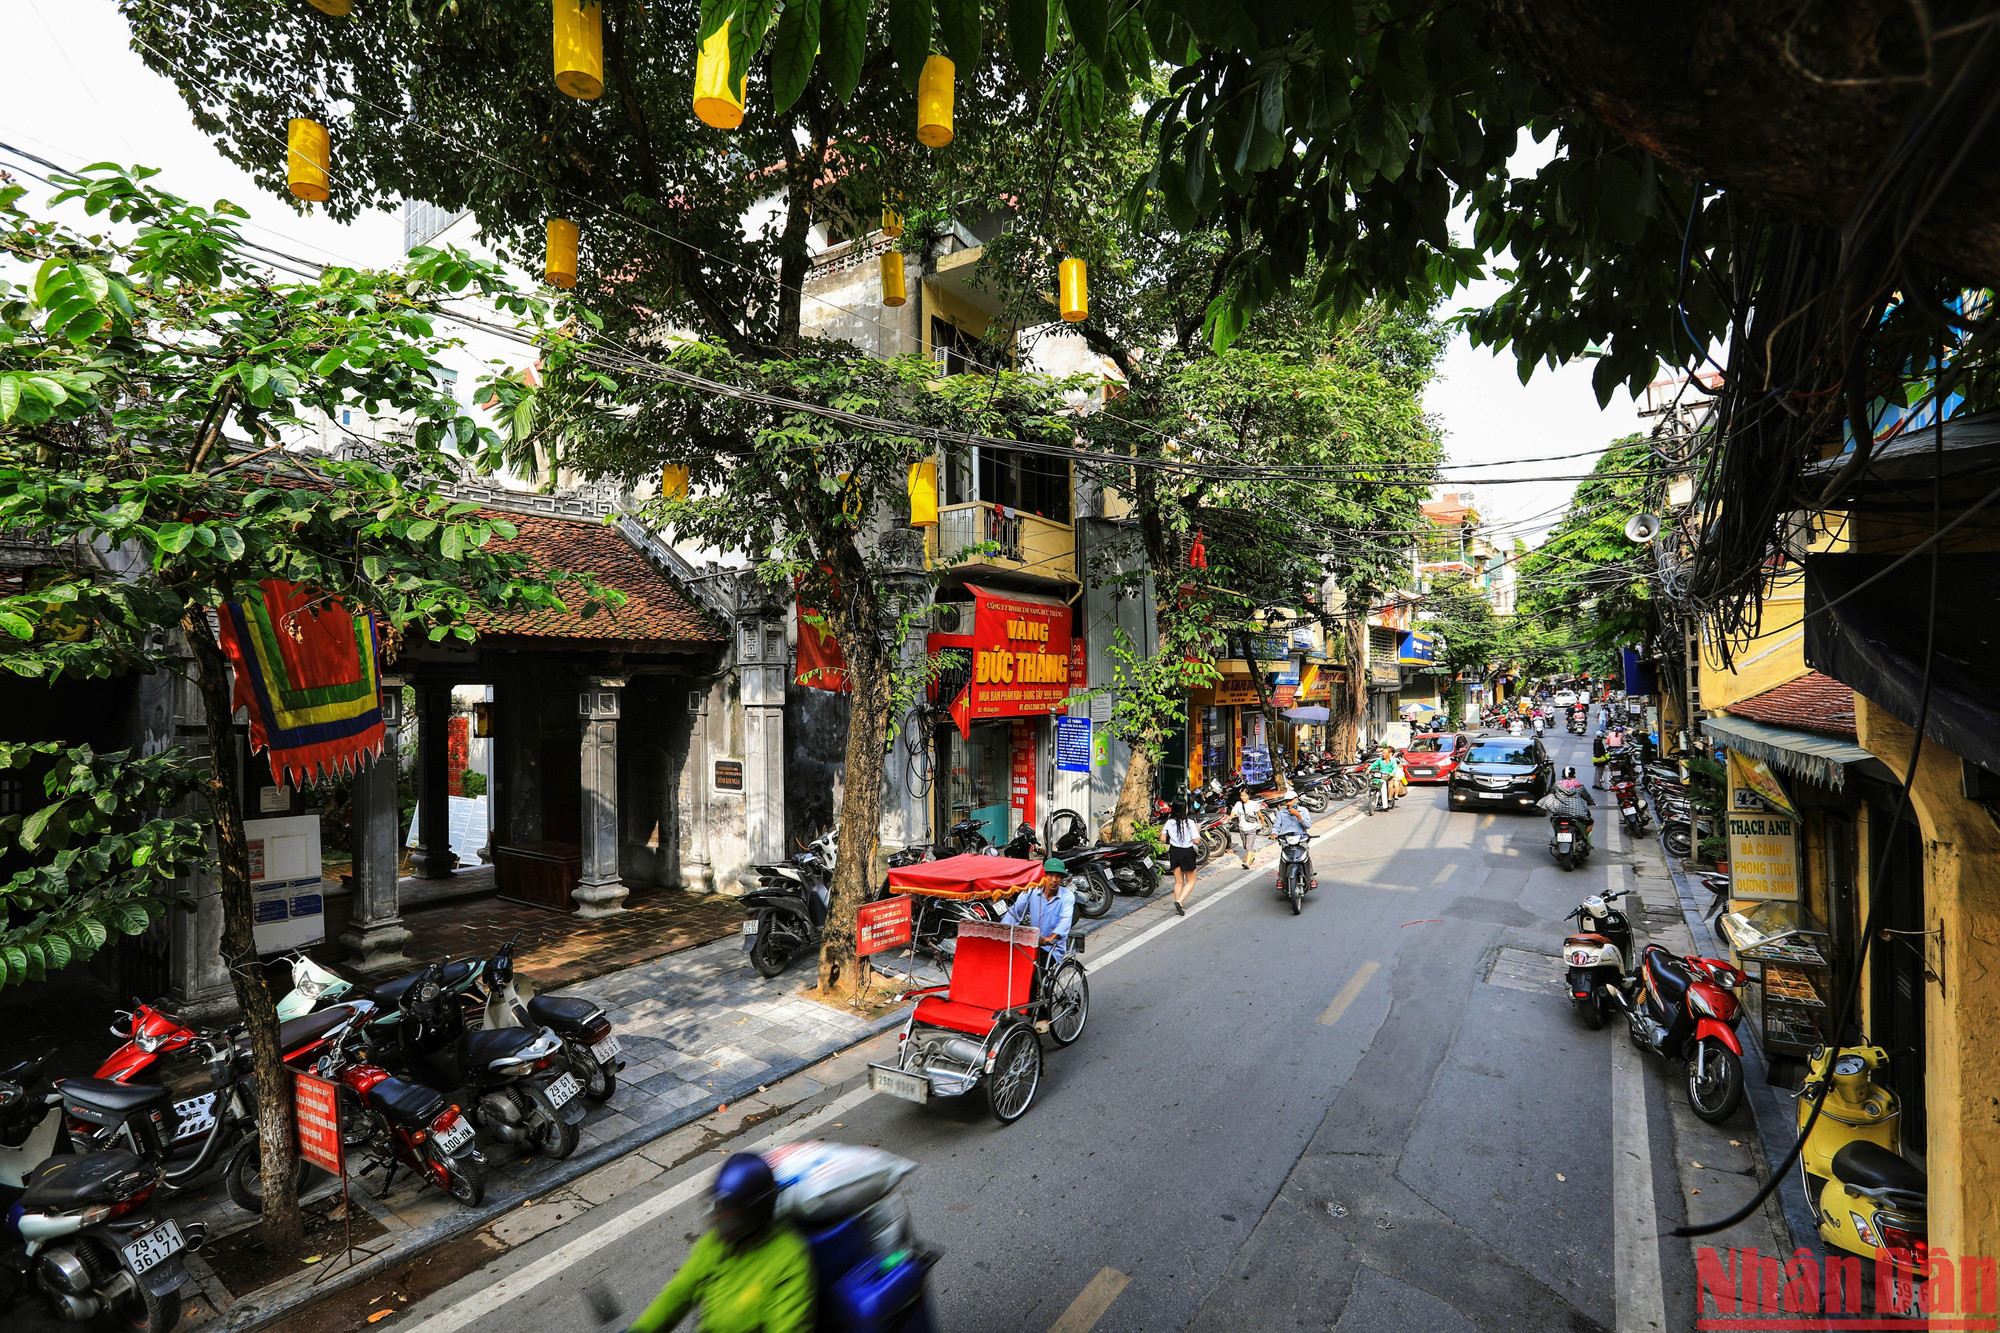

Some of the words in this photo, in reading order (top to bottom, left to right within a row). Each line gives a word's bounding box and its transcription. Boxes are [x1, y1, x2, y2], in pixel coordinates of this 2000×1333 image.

[1006, 616, 1049, 642] VÀNG
[976, 644, 1014, 684] ĐỨC
[1016, 644, 1068, 683] THẮNG
[1730, 820, 1765, 838] THẠCH
[1768, 820, 1791, 836] ANH
[1741, 840, 1754, 855] ĐÁ
[1756, 839, 1783, 856] CẢNH
[1734, 861, 1766, 875] PHONG
[1736, 876, 1769, 893] DƯỠNG
[1771, 881, 1795, 894] SINH
[600, 1044, 618, 1060] 5591
[549, 1076, 571, 1097] 29-G1
[553, 1083, 578, 1107] 419.45
[444, 1124, 458, 1137] 29
[132, 1226, 170, 1257] 29-G1
[134, 1236, 181, 1272] 361.71
